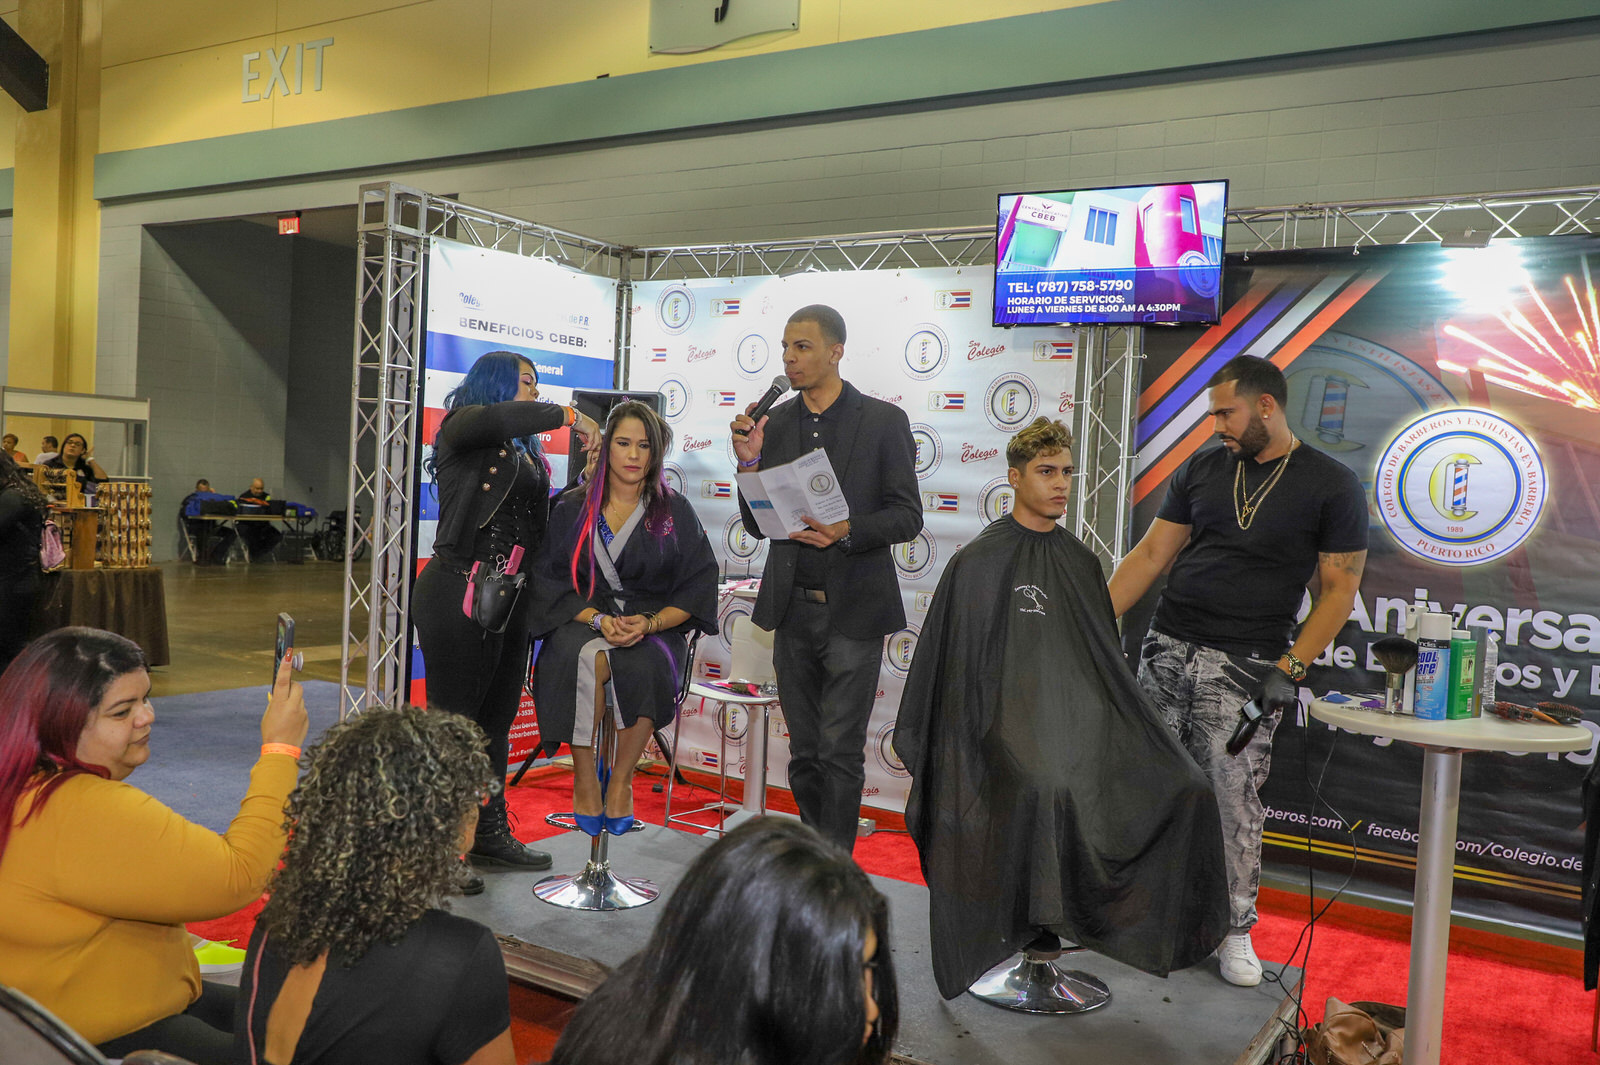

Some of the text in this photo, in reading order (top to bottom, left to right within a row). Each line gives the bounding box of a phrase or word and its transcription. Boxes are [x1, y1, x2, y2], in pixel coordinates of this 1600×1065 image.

[241, 36, 335, 104] EXIT
[1031, 211, 1056, 222] CBEB
[1007, 282, 1034, 293] TEL:
[1036, 281, 1069, 294] (787)
[1071, 279, 1134, 292] 758-5790
[1007, 295, 1125, 305] HORARIO DE SERVICIOS:
[1007, 303, 1181, 314] LUNES A VIERNES DE 8:00 AM A 4:30PM
[459, 317, 587, 348] BENEFICIOS CBEB:
[967, 345, 1006, 361] Colegio
[1456, 417, 1463, 425] Y
[1397, 418, 1453, 453] BARBEROS
[1467, 417, 1526, 454] ESTILISTAS
[683, 439, 712, 452] Colegio
[961, 447, 999, 463] Colegio
[1388, 452, 1401, 468] DE
[1521, 453, 1535, 469] EN
[1383, 469, 1398, 518] COLEGIO
[1416, 538, 1495, 558] PUERTO RICO
[1417, 662, 1436, 675] are
[1552, 666, 1580, 698] y
[1262, 805, 1343, 830] beros.com
